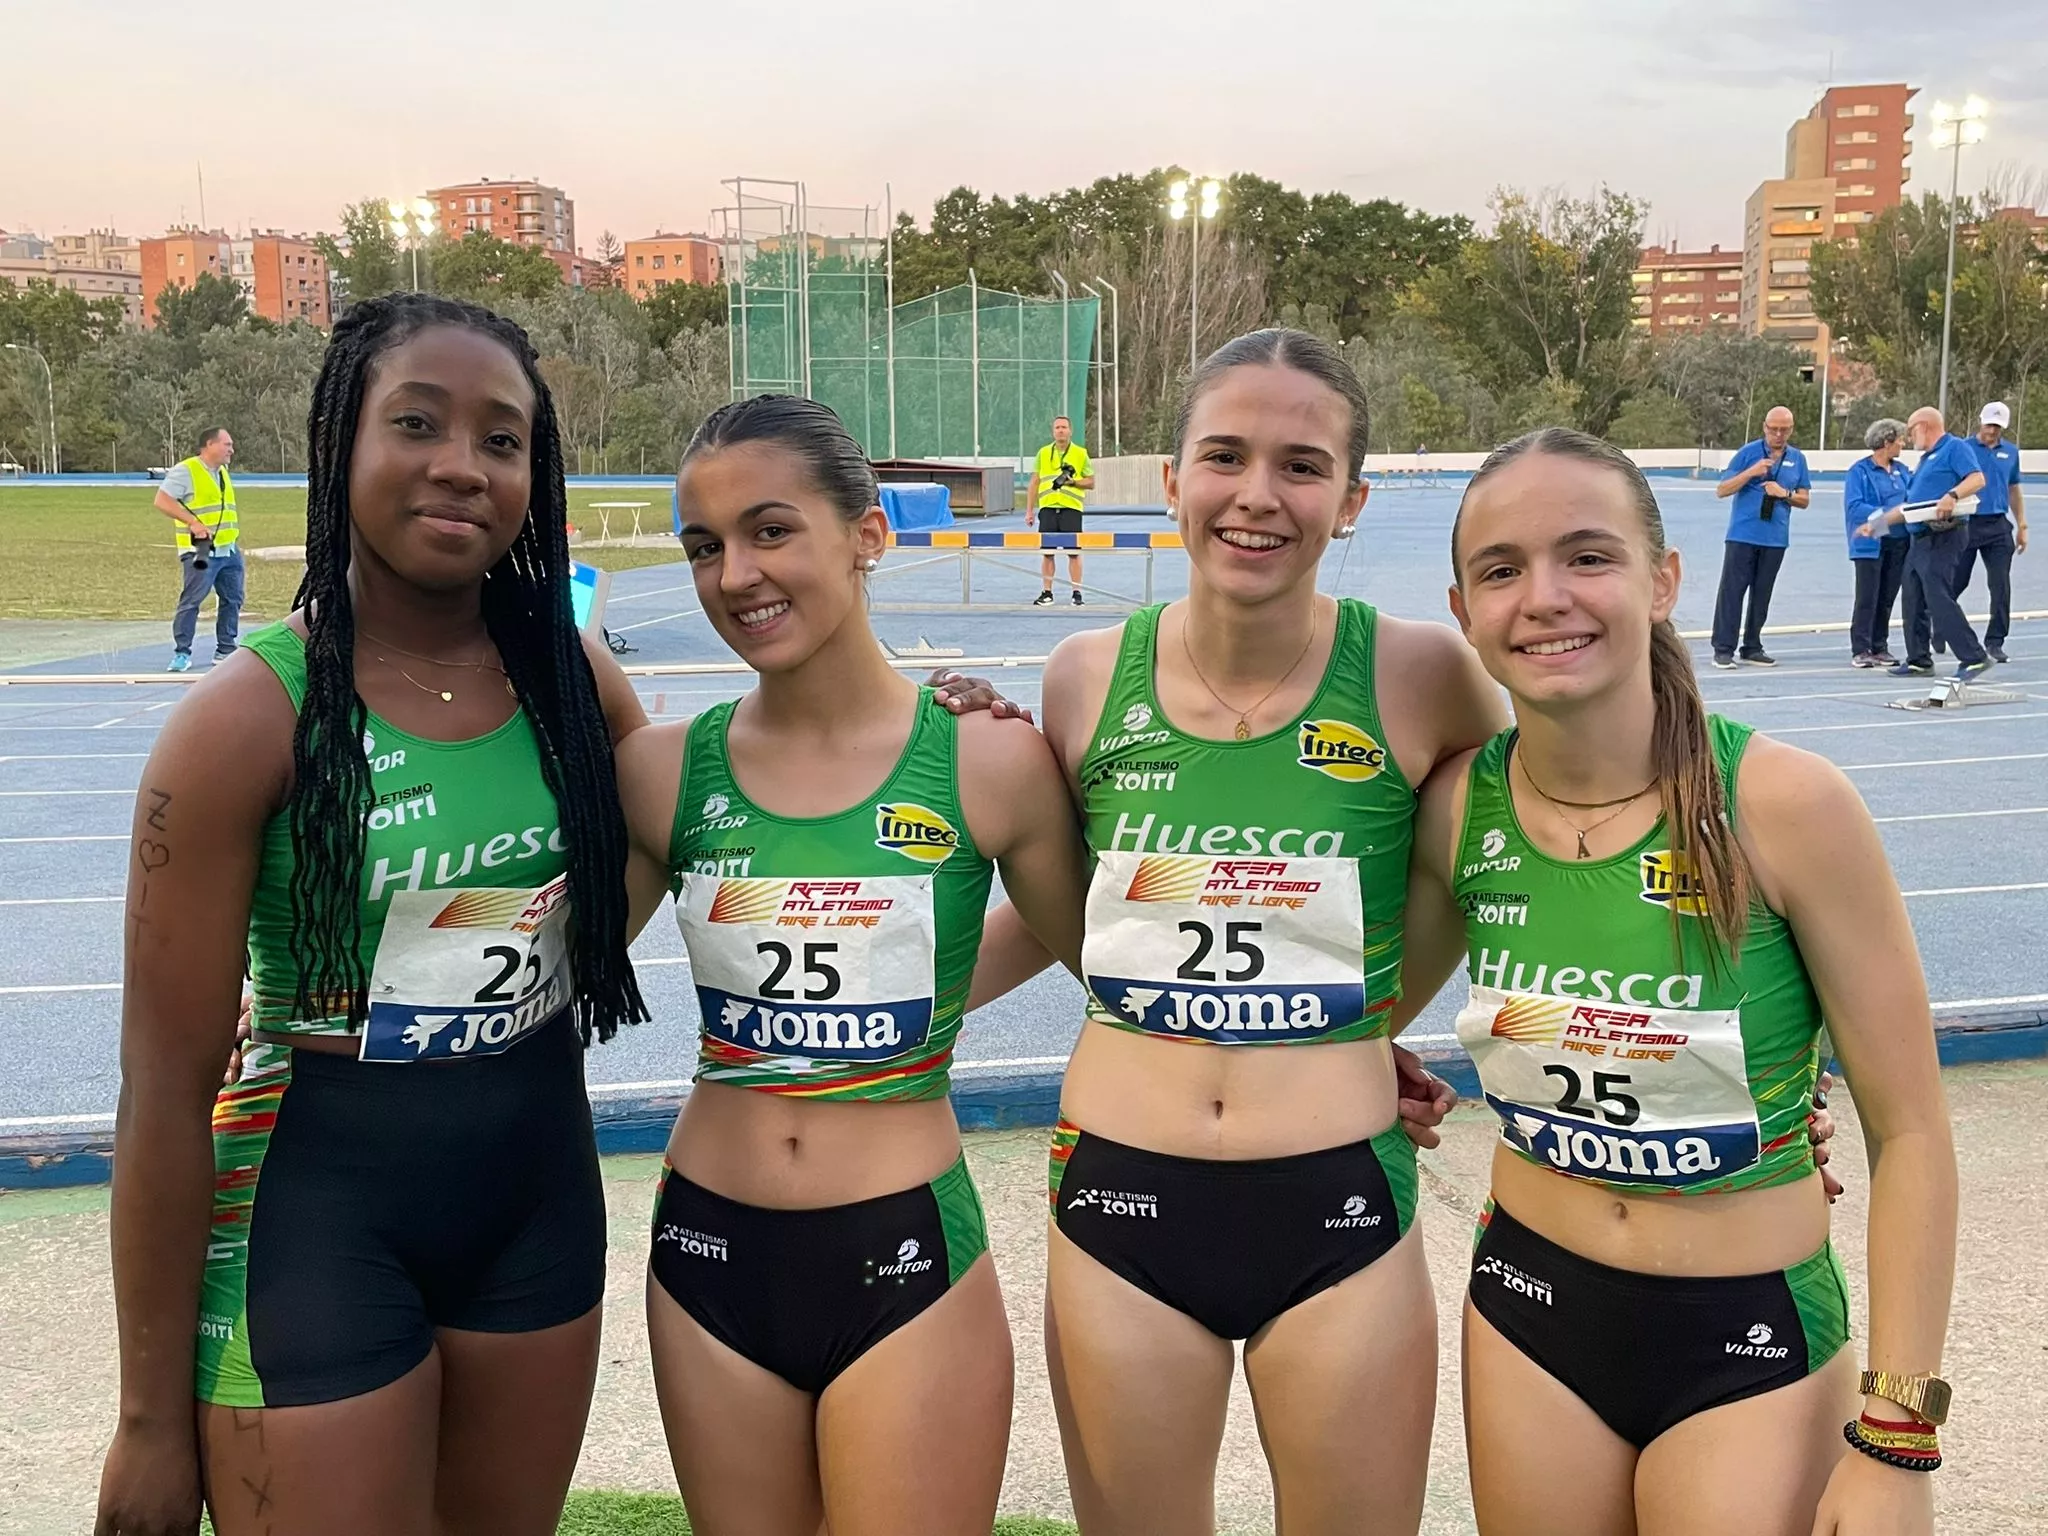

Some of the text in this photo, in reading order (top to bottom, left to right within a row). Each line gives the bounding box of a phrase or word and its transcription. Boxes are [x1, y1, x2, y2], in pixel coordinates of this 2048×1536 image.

[1115, 761, 1179, 771] ATLETISMO
[1114, 771, 1176, 791] ZOITI
[360, 795, 437, 830] OITI
[1110, 812, 1344, 858] Huesca
[368, 826, 569, 900] Huesc
[1211, 861, 1288, 878] RFEA
[788, 882, 861, 899] RFEA
[1205, 879, 1321, 893] ATLETISMO
[782, 900, 894, 911] ATLETISMO
[1198, 894, 1307, 910] AIRE LIBRE
[1479, 892, 1531, 904] ATLETISMO
[775, 915, 881, 929] AIRE LIBRE
[1477, 904, 1528, 927] ZOITI
[1177, 920, 1265, 982] 25
[756, 941, 841, 1001] 25
[1478, 948, 1703, 1009] Huesca
[1164, 990, 1329, 1031] Joma
[1571, 1006, 1652, 1028] RFEA
[752, 1006, 901, 1049] Joma
[1566, 1025, 1689, 1046] ATLETISMO
[1561, 1040, 1677, 1063] AIRE LIBRE
[1542, 1064, 1640, 1126] 25
[1547, 1124, 1721, 1177] Joma
[1100, 1190, 1157, 1202] ATLETISMO
[1102, 1198, 1158, 1218] ZOITI
[1325, 1215, 1381, 1229] VIATOR
[679, 1227, 728, 1247] ATLETISMO
[680, 1236, 727, 1261] ZOITI
[878, 1259, 932, 1276] VIATOR
[1503, 1263, 1552, 1291] ATLETISMO
[1503, 1271, 1552, 1306] ZOITI
[198, 1321, 234, 1341] OITI
[1725, 1342, 1788, 1359] VIATOR
